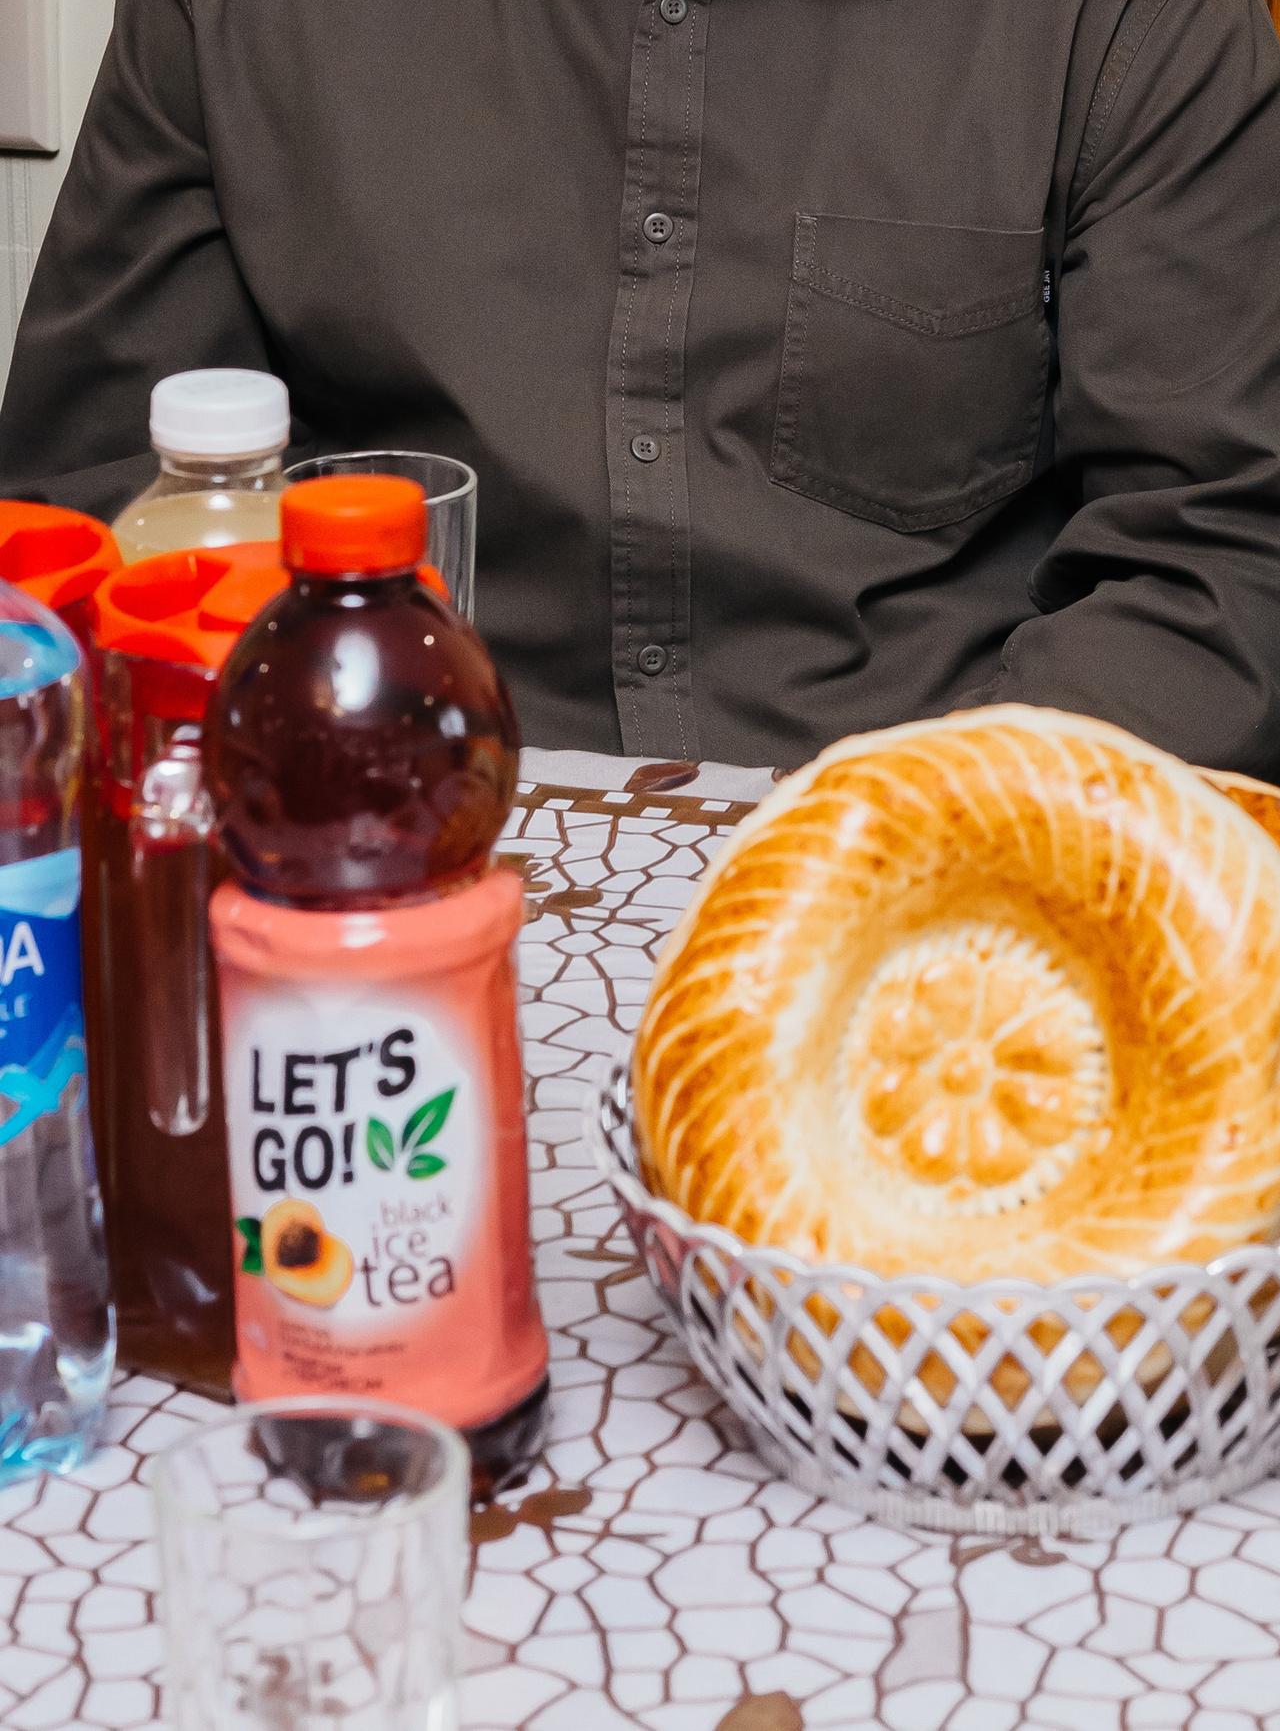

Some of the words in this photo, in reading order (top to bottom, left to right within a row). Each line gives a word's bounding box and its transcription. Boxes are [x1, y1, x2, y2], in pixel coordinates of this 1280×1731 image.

[252, 1028, 416, 1115] LET'S
[254, 1123, 355, 1191] GO!
[380, 1191, 451, 1227] black
[372, 1223, 429, 1260] ice
[360, 1256, 456, 1307] tea
